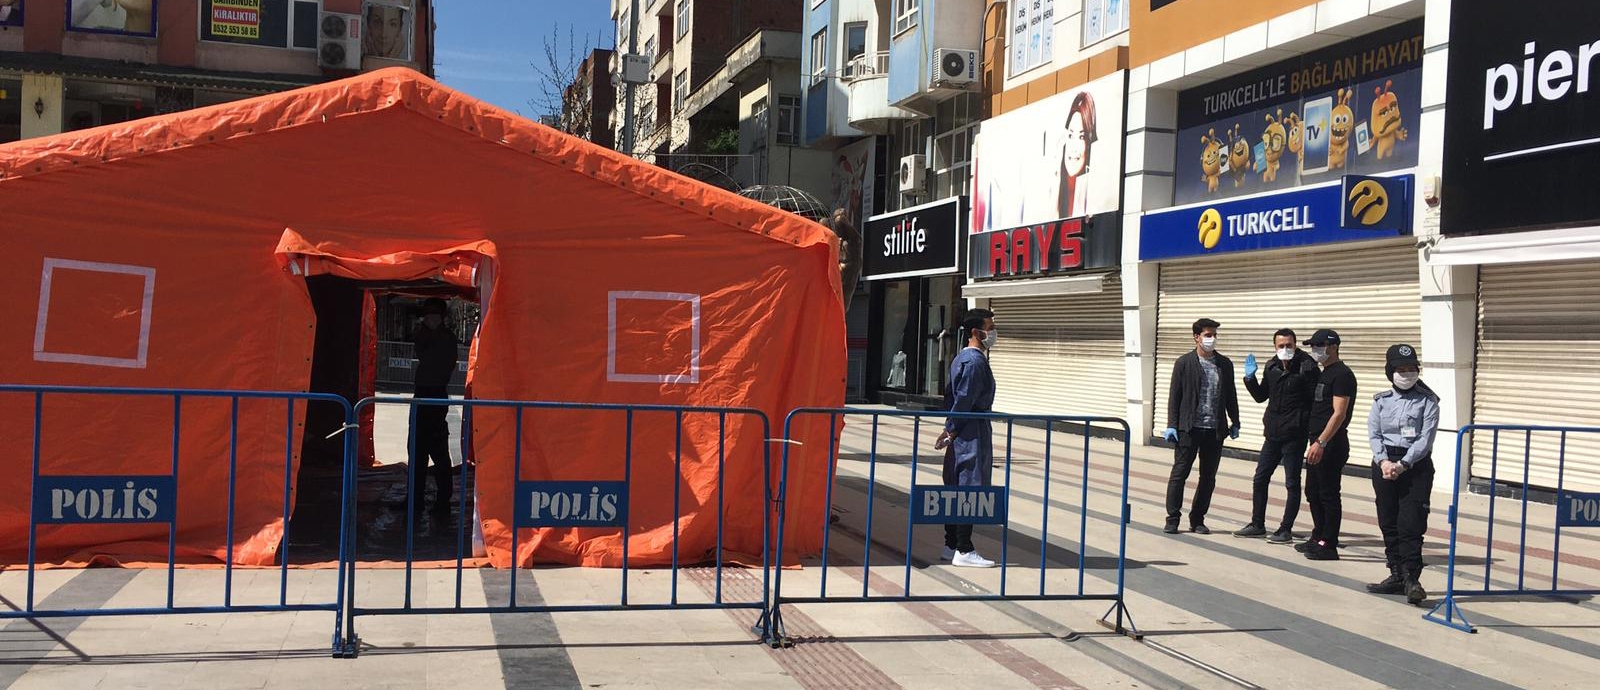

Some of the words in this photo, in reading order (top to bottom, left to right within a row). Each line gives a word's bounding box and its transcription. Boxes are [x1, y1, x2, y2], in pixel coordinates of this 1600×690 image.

[1203, 75, 1286, 116] TURKCELL'LE
[1289, 55, 1357, 95] BAĞLAN
[1483, 40, 1600, 130] pier
[883, 216, 926, 257] stilife
[1227, 205, 1315, 237] TURKCELL
[989, 219, 1083, 276] RAYS
[51, 481, 158, 519] POLİS
[530, 486, 618, 522] POLİS
[923, 490, 995, 517] BTMN
[1570, 498, 1600, 522] PO
